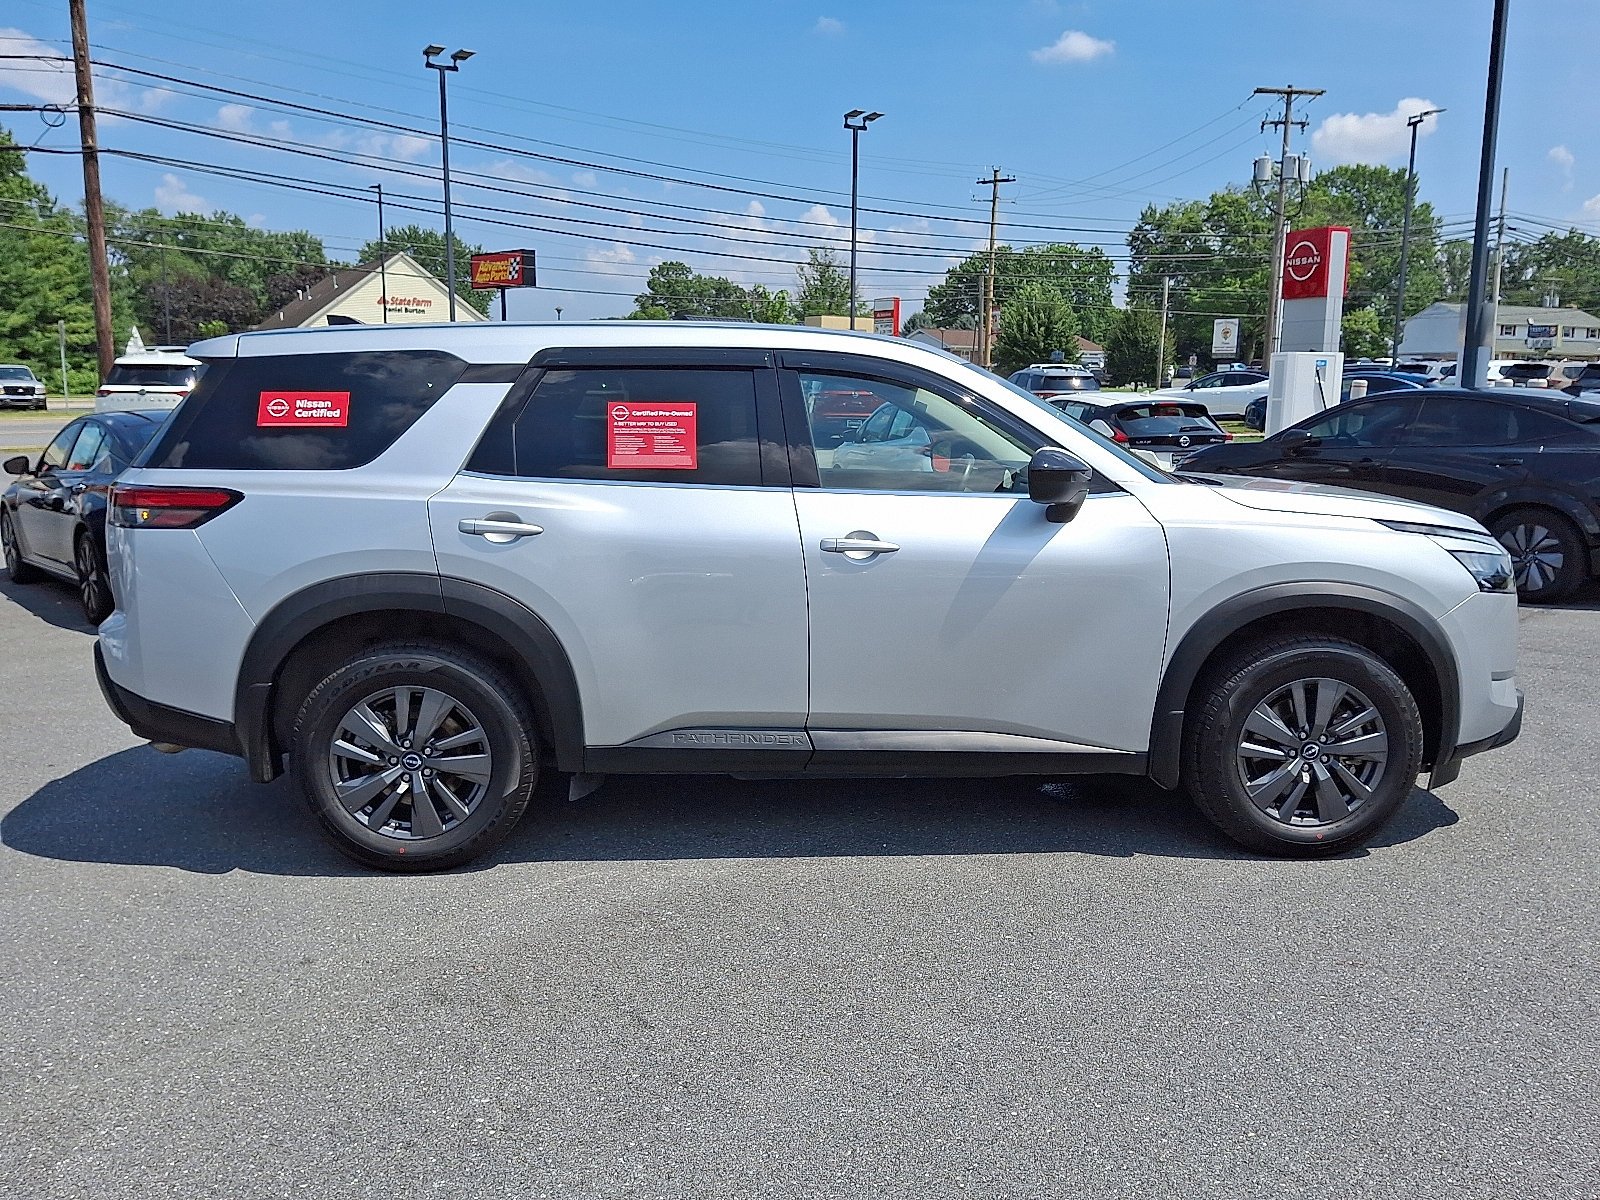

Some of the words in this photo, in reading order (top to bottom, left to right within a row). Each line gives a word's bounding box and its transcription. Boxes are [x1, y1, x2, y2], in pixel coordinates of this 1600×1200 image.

[478, 260, 509, 272] Advance
[1286, 256, 1320, 266] NISSAN
[475, 272, 490, 283] Auto
[490, 270, 509, 281] Parts
[390, 296, 411, 306] State
[412, 297, 432, 307] Farm
[295, 400, 332, 409] Nissan
[294, 409, 341, 418] Certified
[672, 733, 804, 745] PATHFINDER
